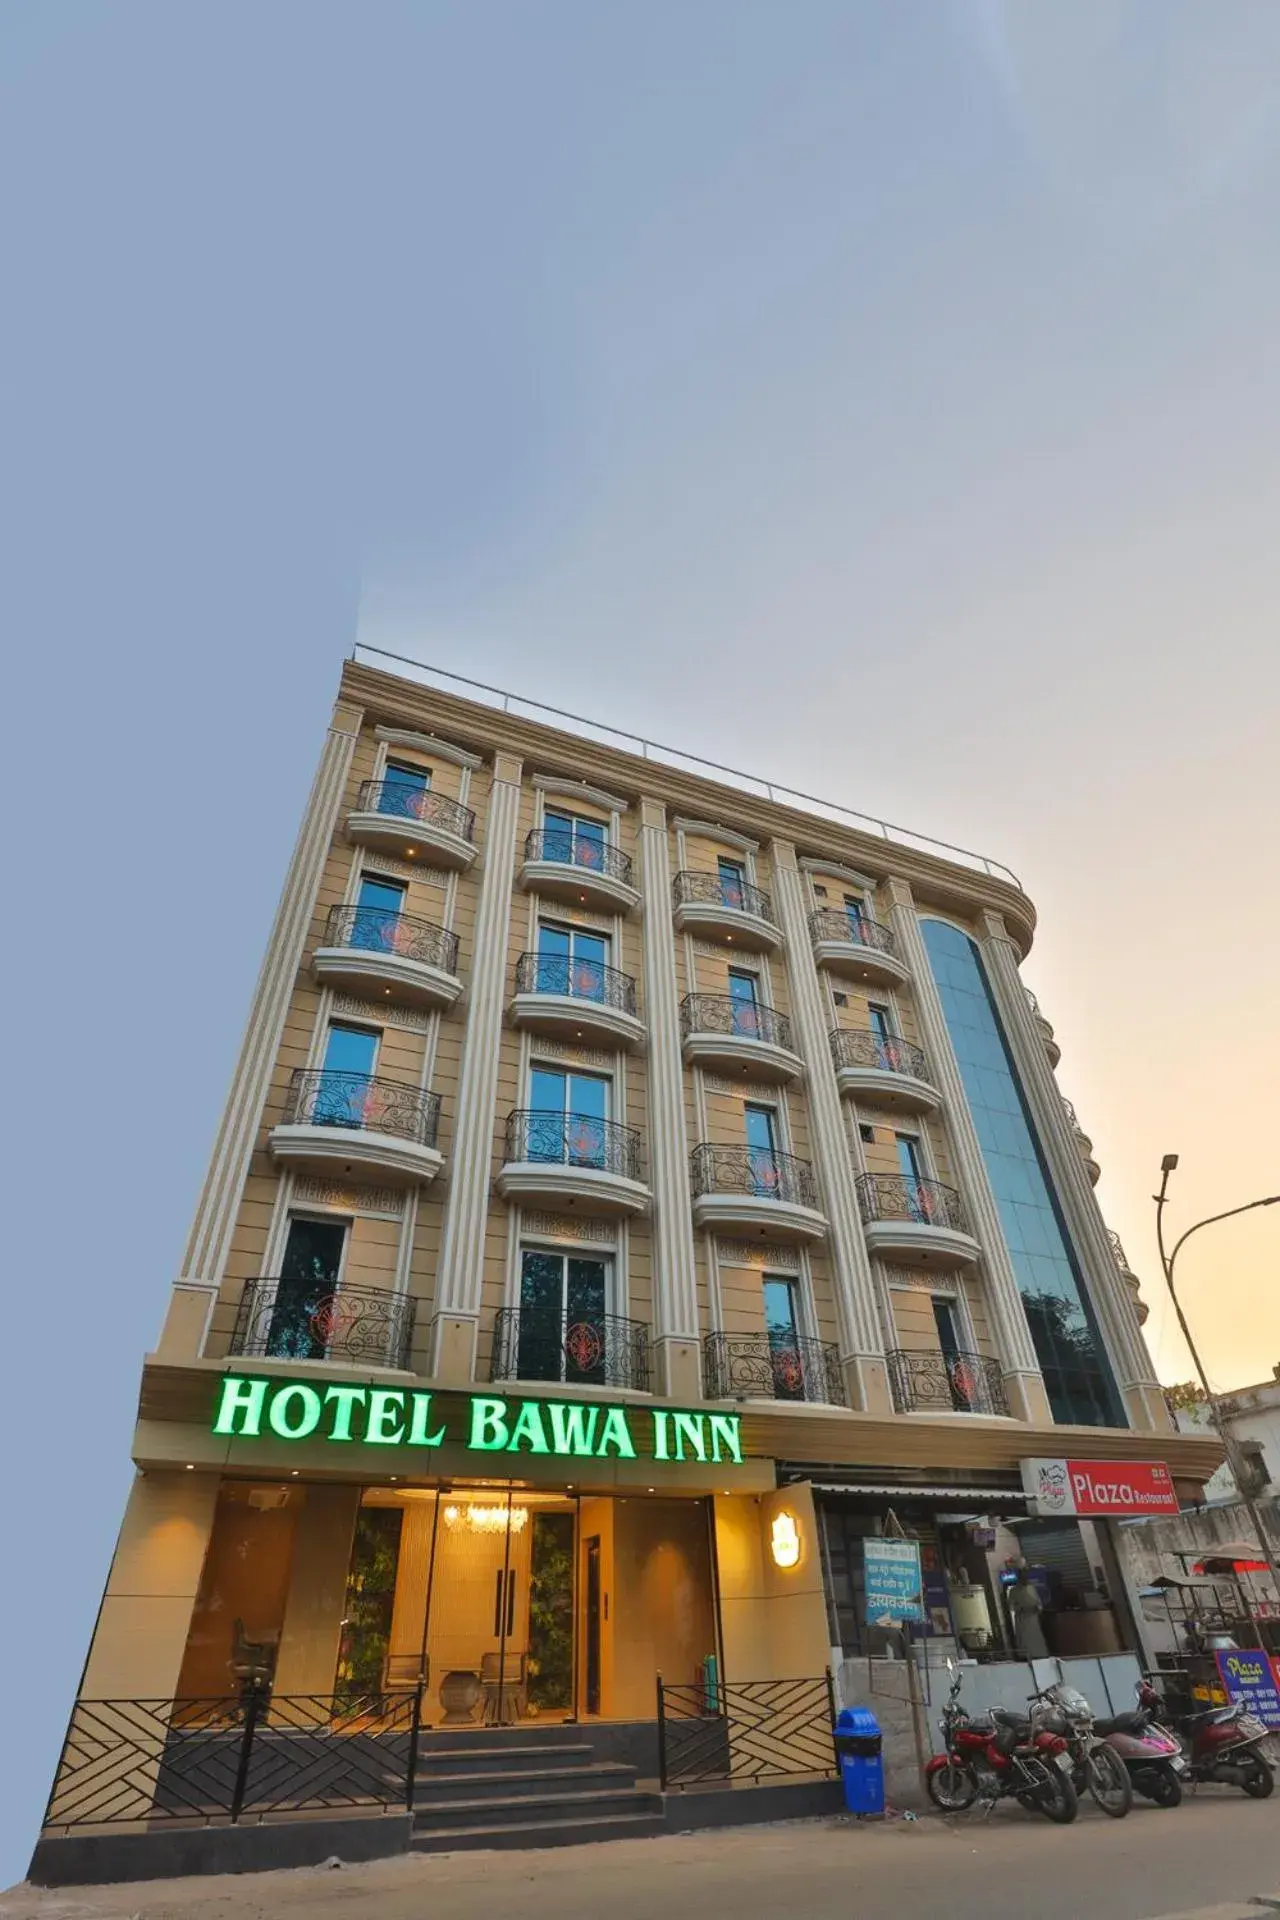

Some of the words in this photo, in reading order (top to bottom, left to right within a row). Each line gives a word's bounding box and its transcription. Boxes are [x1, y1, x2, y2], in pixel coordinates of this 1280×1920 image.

[212, 1378, 446, 1446] HOTEL
[468, 1398, 637, 1458] BAWA
[652, 1411, 743, 1463] INN
[1073, 1474, 1135, 1504] Plaza
[1133, 1491, 1175, 1505] Restaurant
[1227, 1656, 1263, 1678] Plaza
